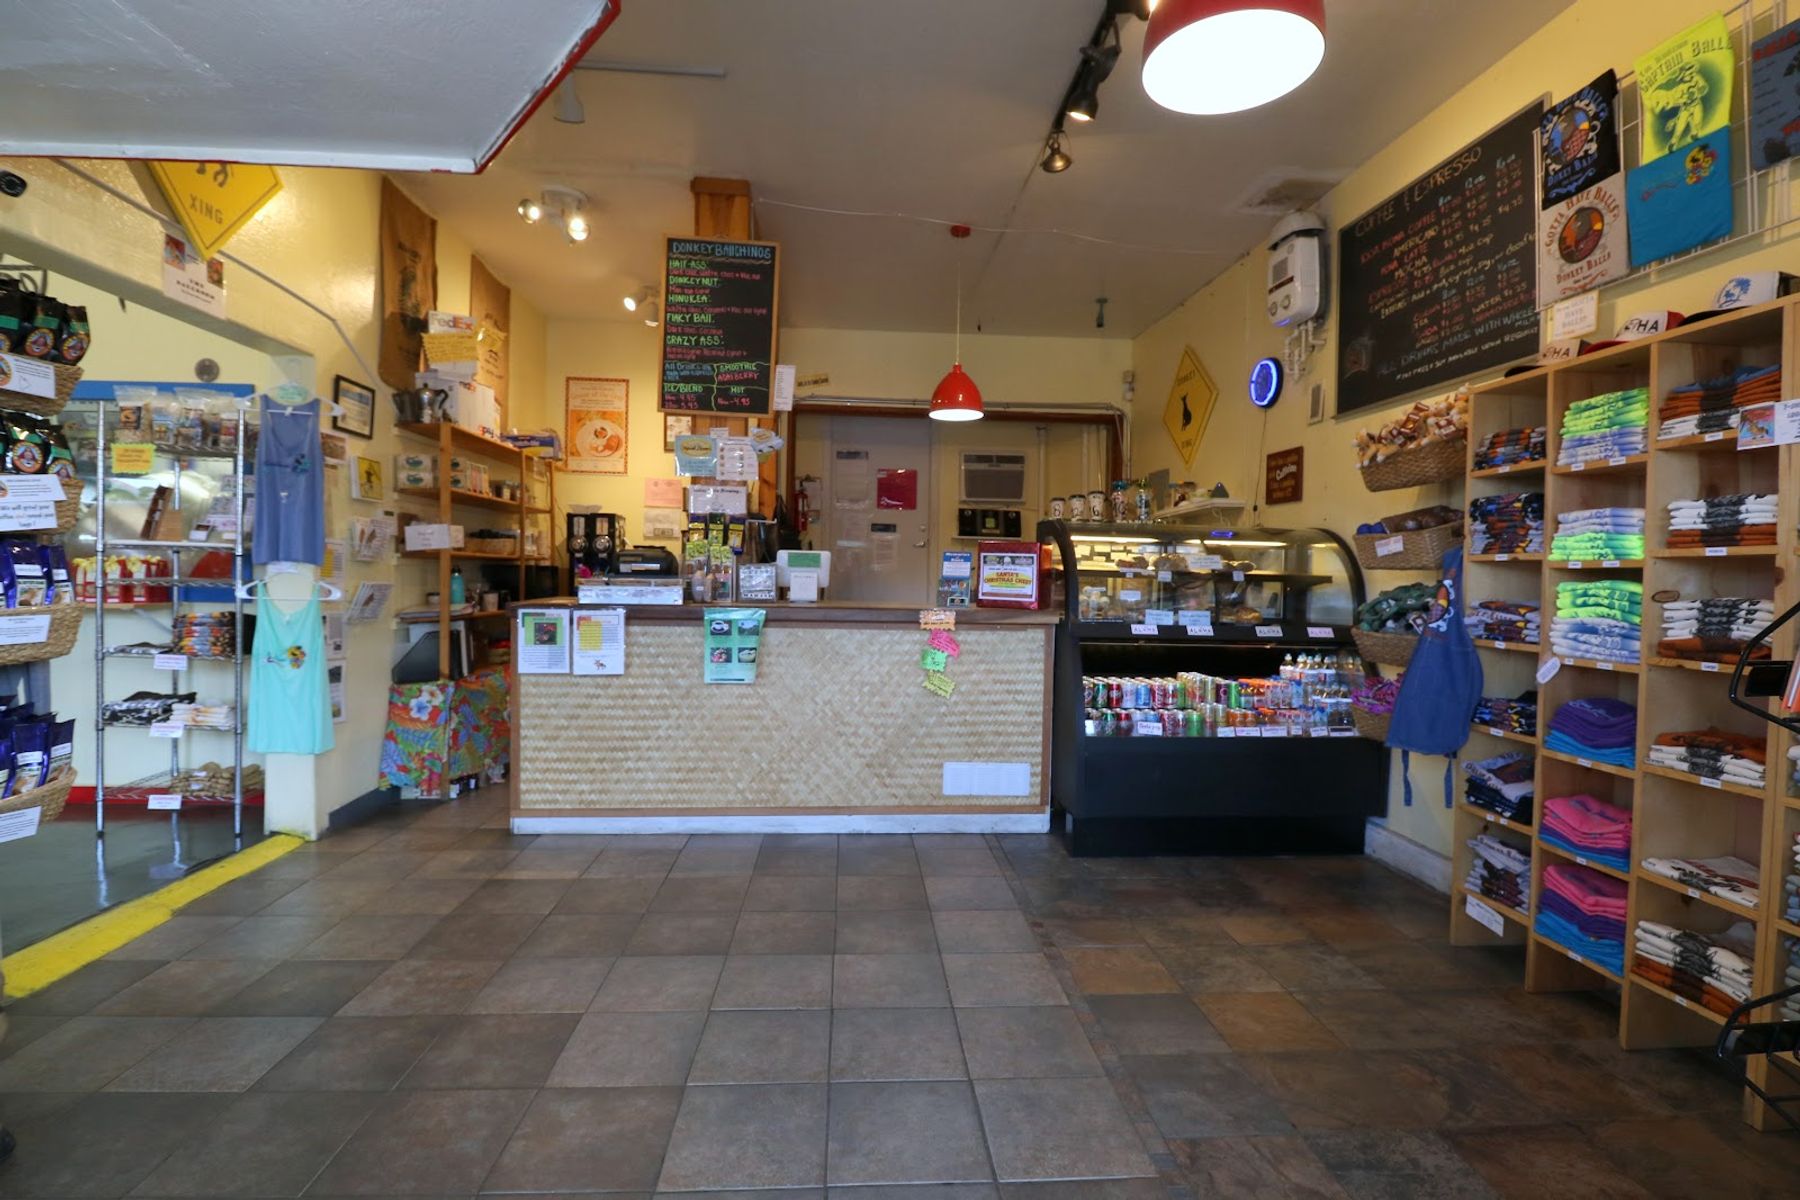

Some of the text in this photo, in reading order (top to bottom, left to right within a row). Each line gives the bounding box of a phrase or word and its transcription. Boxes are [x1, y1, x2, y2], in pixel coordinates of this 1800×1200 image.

[1565, 189, 1592, 211] HAVE
[190, 192, 224, 225] XING
[672, 241, 714, 254] DONKEY
[669, 275, 701, 285] DONKEY
[431, 314, 473, 331] FedEx
[1474, 317, 1501, 336] WITH
[666, 335, 698, 346] CRAZY
[730, 385, 746, 394] HOT
[1188, 627, 1213, 636] ALOHA
[1257, 628, 1281, 636] ALOHA
